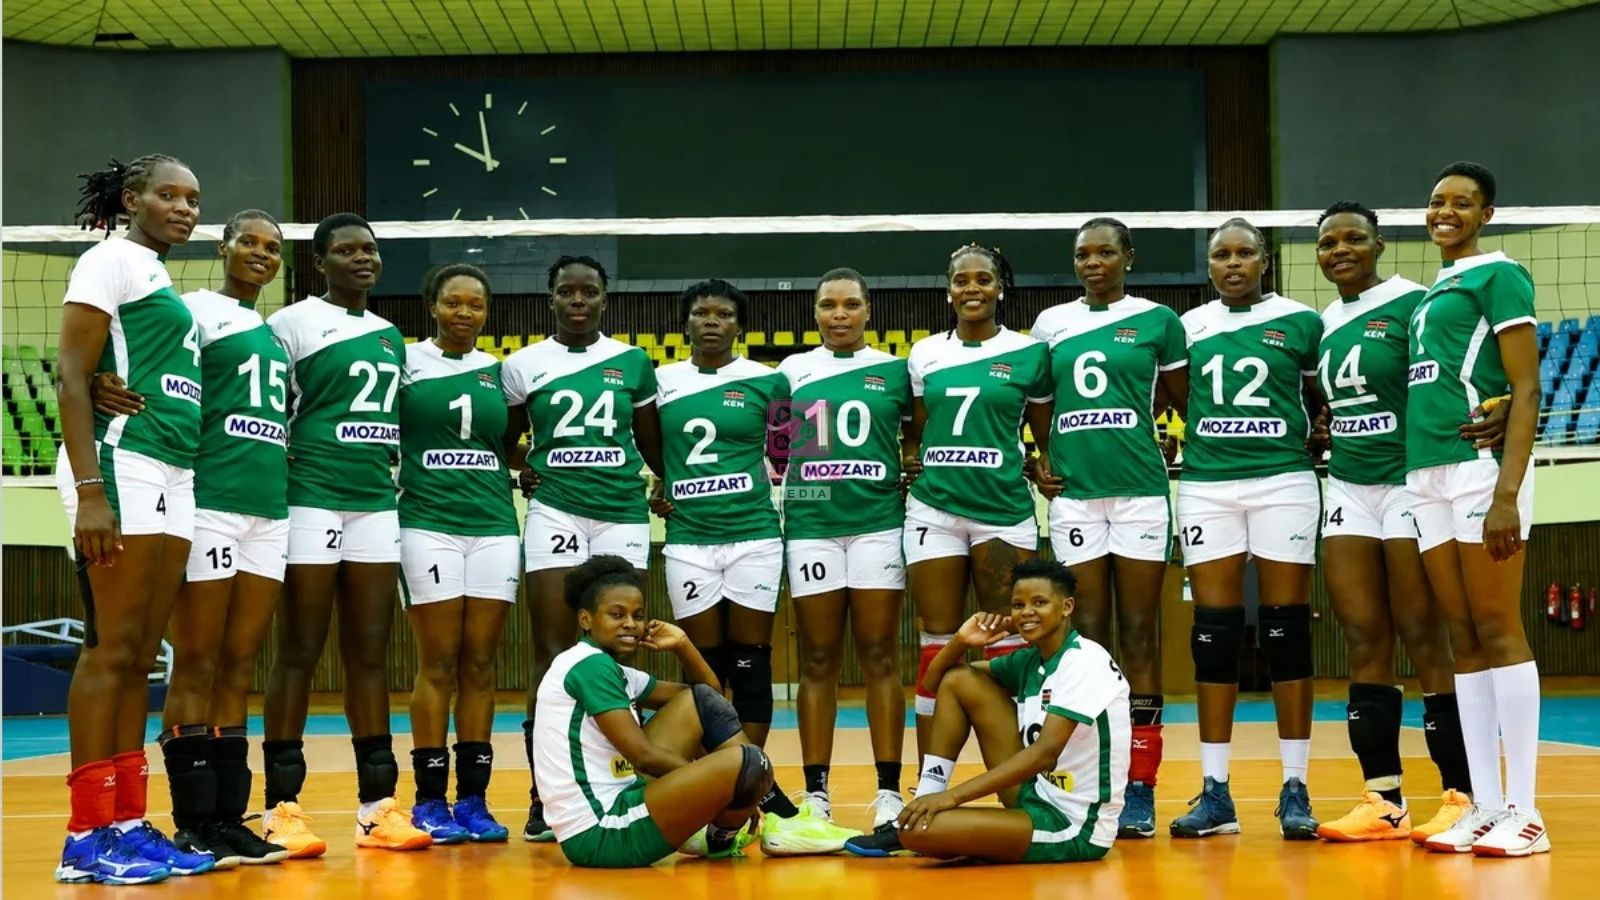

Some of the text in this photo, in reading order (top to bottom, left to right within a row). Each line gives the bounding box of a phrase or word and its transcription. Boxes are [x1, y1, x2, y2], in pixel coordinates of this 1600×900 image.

[183, 324, 201, 367] 4
[1363, 331, 1386, 339] KEN
[237, 353, 287, 413] 15
[1072, 350, 1108, 399] 6
[1201, 354, 1270, 407] 12
[1316, 344, 1367, 401] 14
[348, 360, 401, 413] 27
[449, 393, 473, 440] 1
[550, 389, 618, 438] 24
[945, 386, 981, 436] 7
[1059, 411, 1133, 431] MOZZART
[804, 399, 872, 448] 10
[1200, 420, 1282, 435] MOZZART
[682, 417, 719, 466] 2
[426, 452, 497, 469] MOZZART
[550, 449, 622, 465] MOZZART
[925, 449, 1000, 466] MOZZART
[804, 463, 882, 478] MOZZART
[673, 475, 748, 497] MOZZART
[156, 493, 167, 516] 4
[326, 529, 343, 550] 27
[551, 533, 579, 554] 24
[915, 526, 929, 546] 7
[1069, 527, 1084, 548] 6
[1182, 526, 1205, 548] 12
[206, 547, 233, 570] 15
[428, 563, 441, 585] 1
[799, 561, 826, 583] 10
[682, 580, 699, 601] 2
